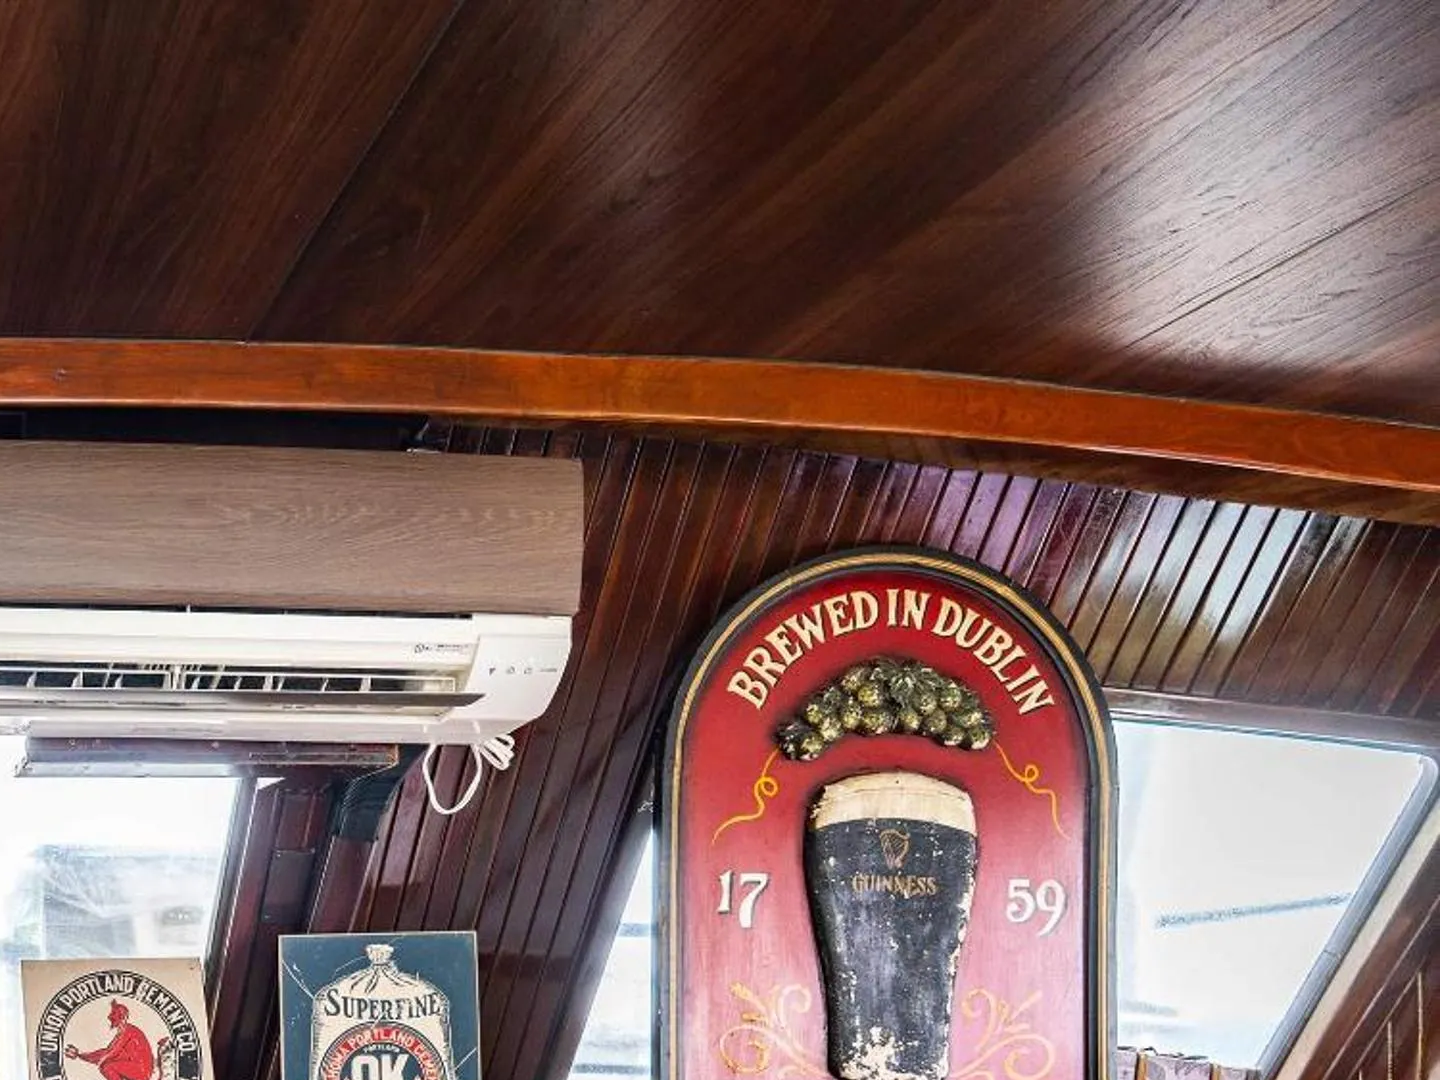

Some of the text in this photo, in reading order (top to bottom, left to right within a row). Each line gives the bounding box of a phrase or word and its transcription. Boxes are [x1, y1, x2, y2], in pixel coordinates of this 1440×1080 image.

[726, 588, 1055, 717] BREWED IN DUBLIN
[716, 869, 1067, 937] 17 59
[851, 873, 939, 897] GUINNESS
[40, 1004, 67, 1052] UNION
[65, 973, 135, 1010] PORTLAND
[324, 987, 442, 1021] SUPERFINE
